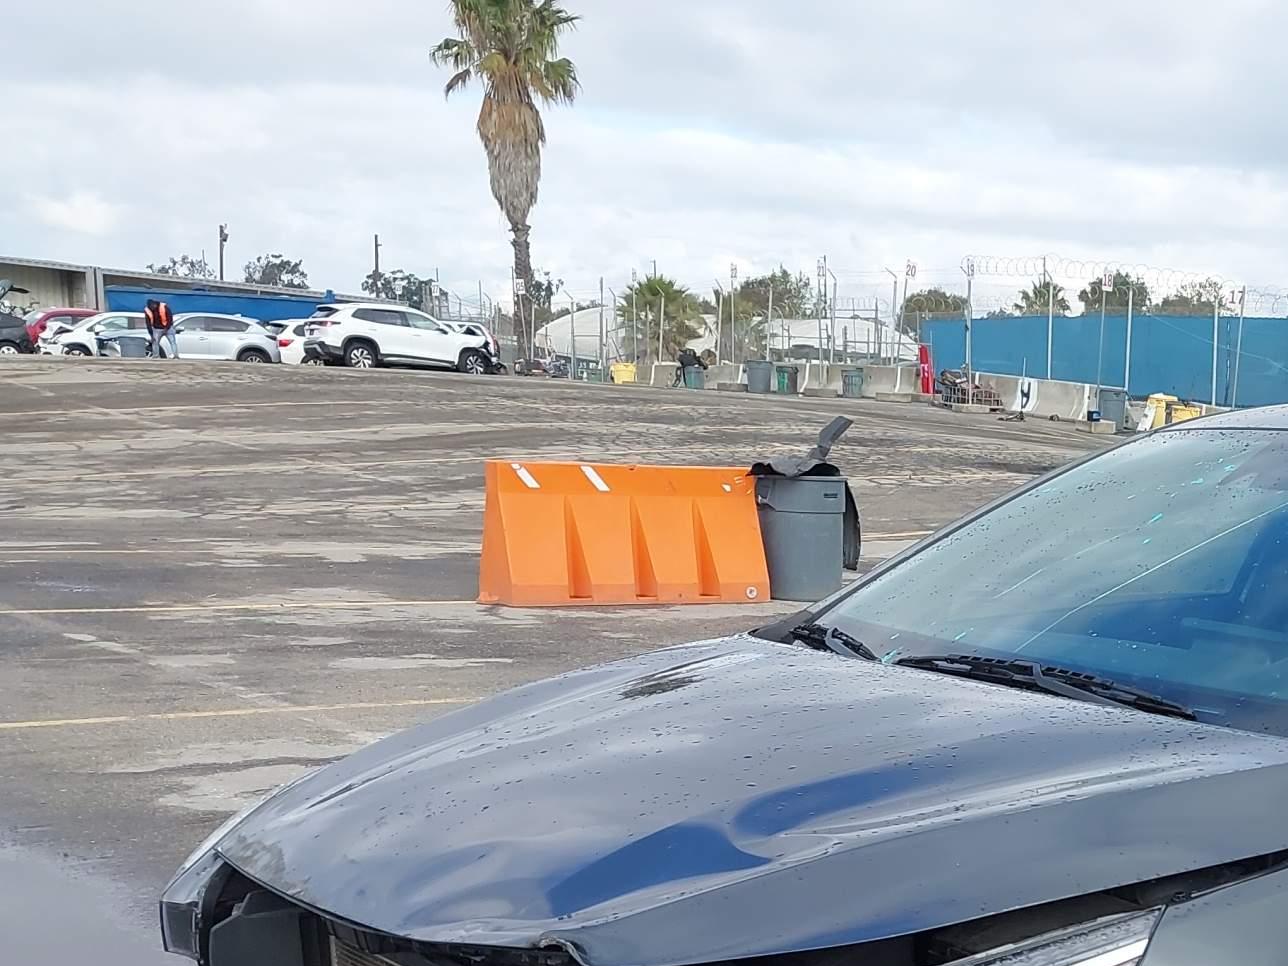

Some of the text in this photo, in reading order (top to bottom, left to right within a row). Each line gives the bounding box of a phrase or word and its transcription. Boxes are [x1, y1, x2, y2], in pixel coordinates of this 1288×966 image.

[906, 264, 916, 277] 20
[967, 264, 975, 277] 19
[1103, 273, 1113, 287] 18
[1228, 290, 1245, 304] 17
